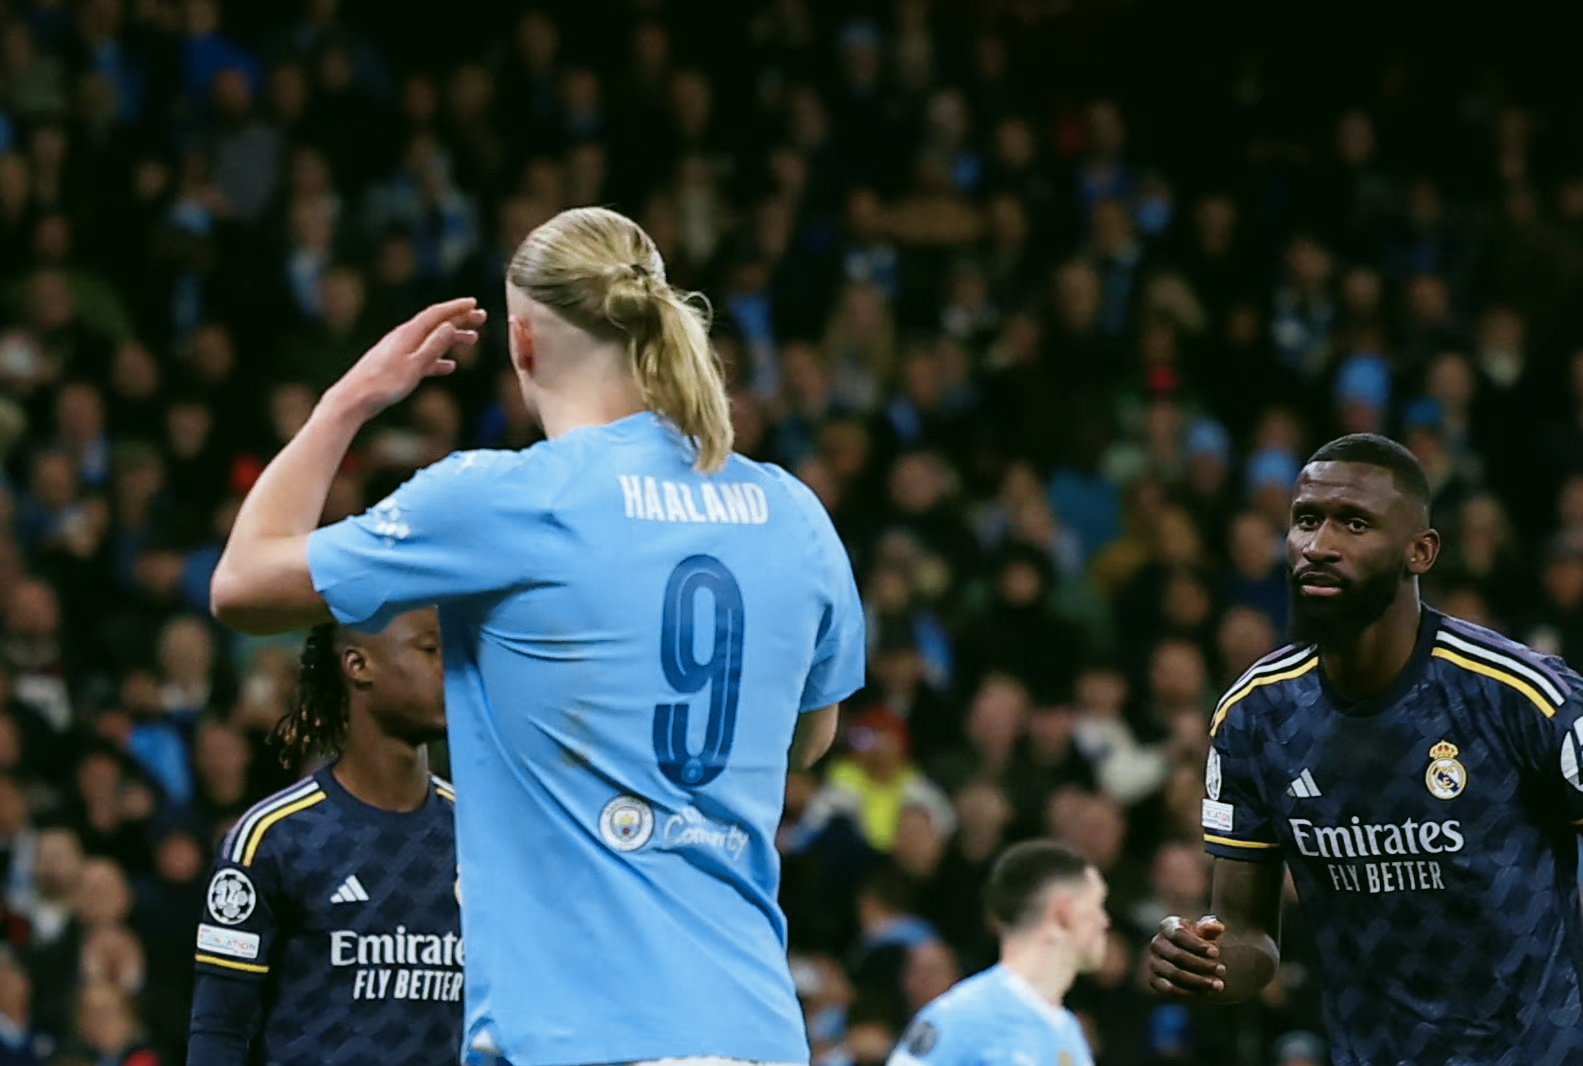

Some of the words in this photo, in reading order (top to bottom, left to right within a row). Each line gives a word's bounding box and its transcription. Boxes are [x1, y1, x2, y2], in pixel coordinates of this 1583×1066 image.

[619, 474, 769, 525] HAALAND
[653, 554, 745, 787] 9
[1288, 815, 1465, 859] Emirates
[1327, 862, 1361, 894] FLY
[1366, 860, 1447, 895] BETTER
[352, 967, 393, 1001] FLY
[393, 968, 464, 1003] BETTER
